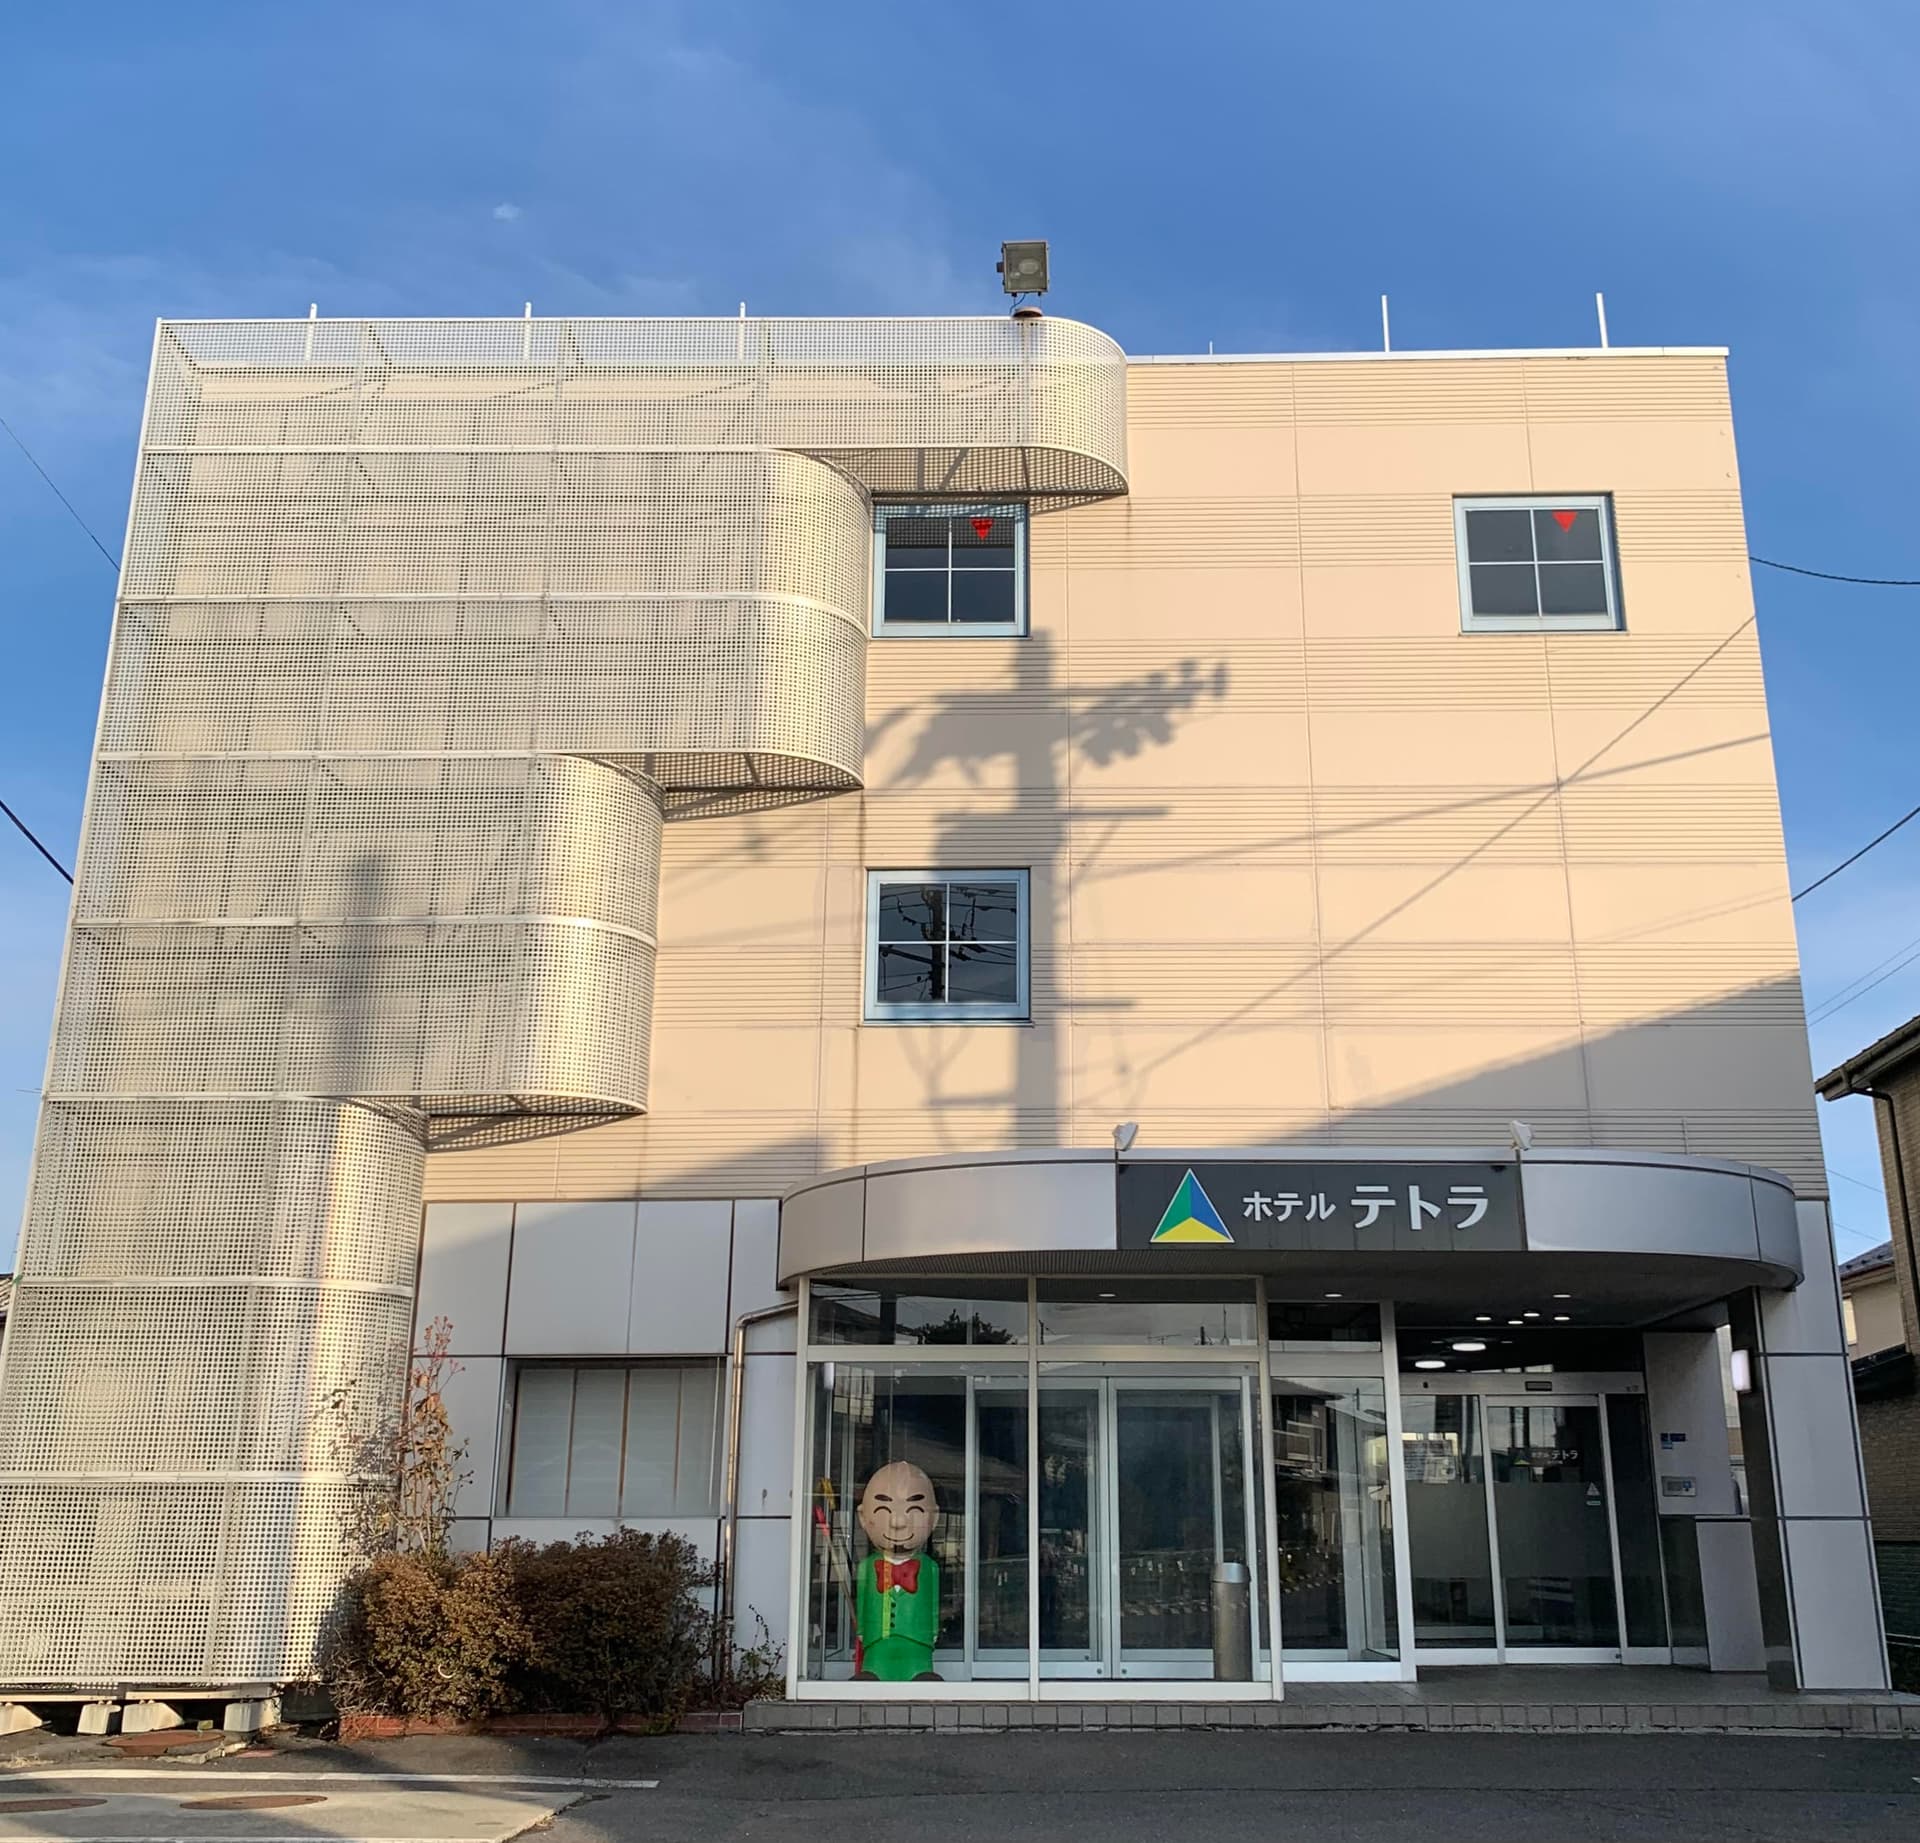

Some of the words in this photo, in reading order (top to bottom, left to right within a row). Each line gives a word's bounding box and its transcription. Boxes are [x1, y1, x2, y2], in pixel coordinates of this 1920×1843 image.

[1243, 1191, 1336, 1222] ホテル
[1351, 1185, 1488, 1230] テトラ
[1552, 1449, 1578, 1460] テトラ
